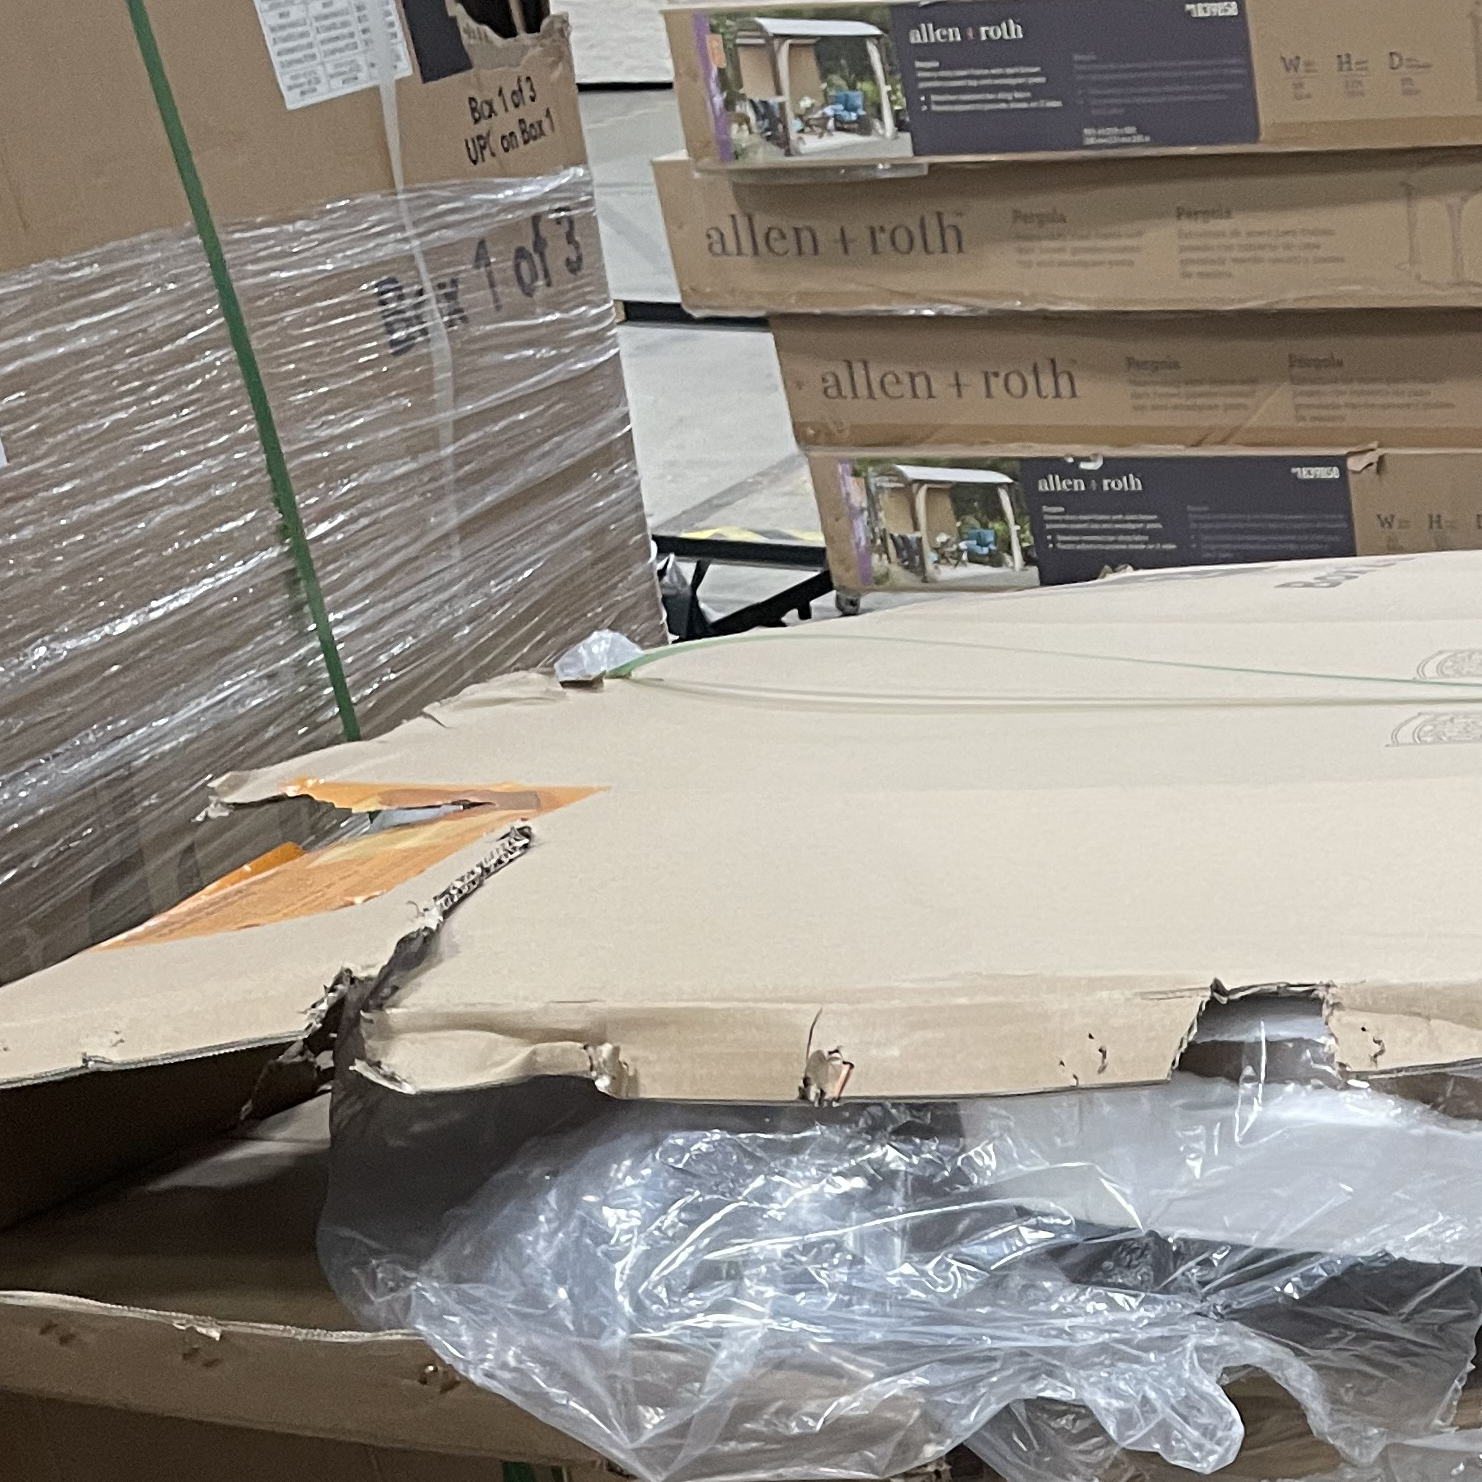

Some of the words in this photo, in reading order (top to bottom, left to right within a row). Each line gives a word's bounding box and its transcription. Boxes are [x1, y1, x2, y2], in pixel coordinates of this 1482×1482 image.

[909, 22, 961, 44] allen
[979, 18, 1024, 41] roth
[468, 96, 498, 125] Box
[498, 86, 509, 113] 1
[510, 75, 526, 109] of
[526, 76, 537, 102] 3
[464, 129, 496, 166] UPC
[500, 131, 519, 153] on
[518, 118, 547, 145] Box
[545, 107, 555, 133] 1
[706, 213, 821, 258] allen
[868, 212, 966, 257] roth
[820, 359, 935, 402] allen
[981, 357, 1079, 401] roth
[1037, 473, 1086, 492] allen
[1102, 473, 1143, 492] roth
